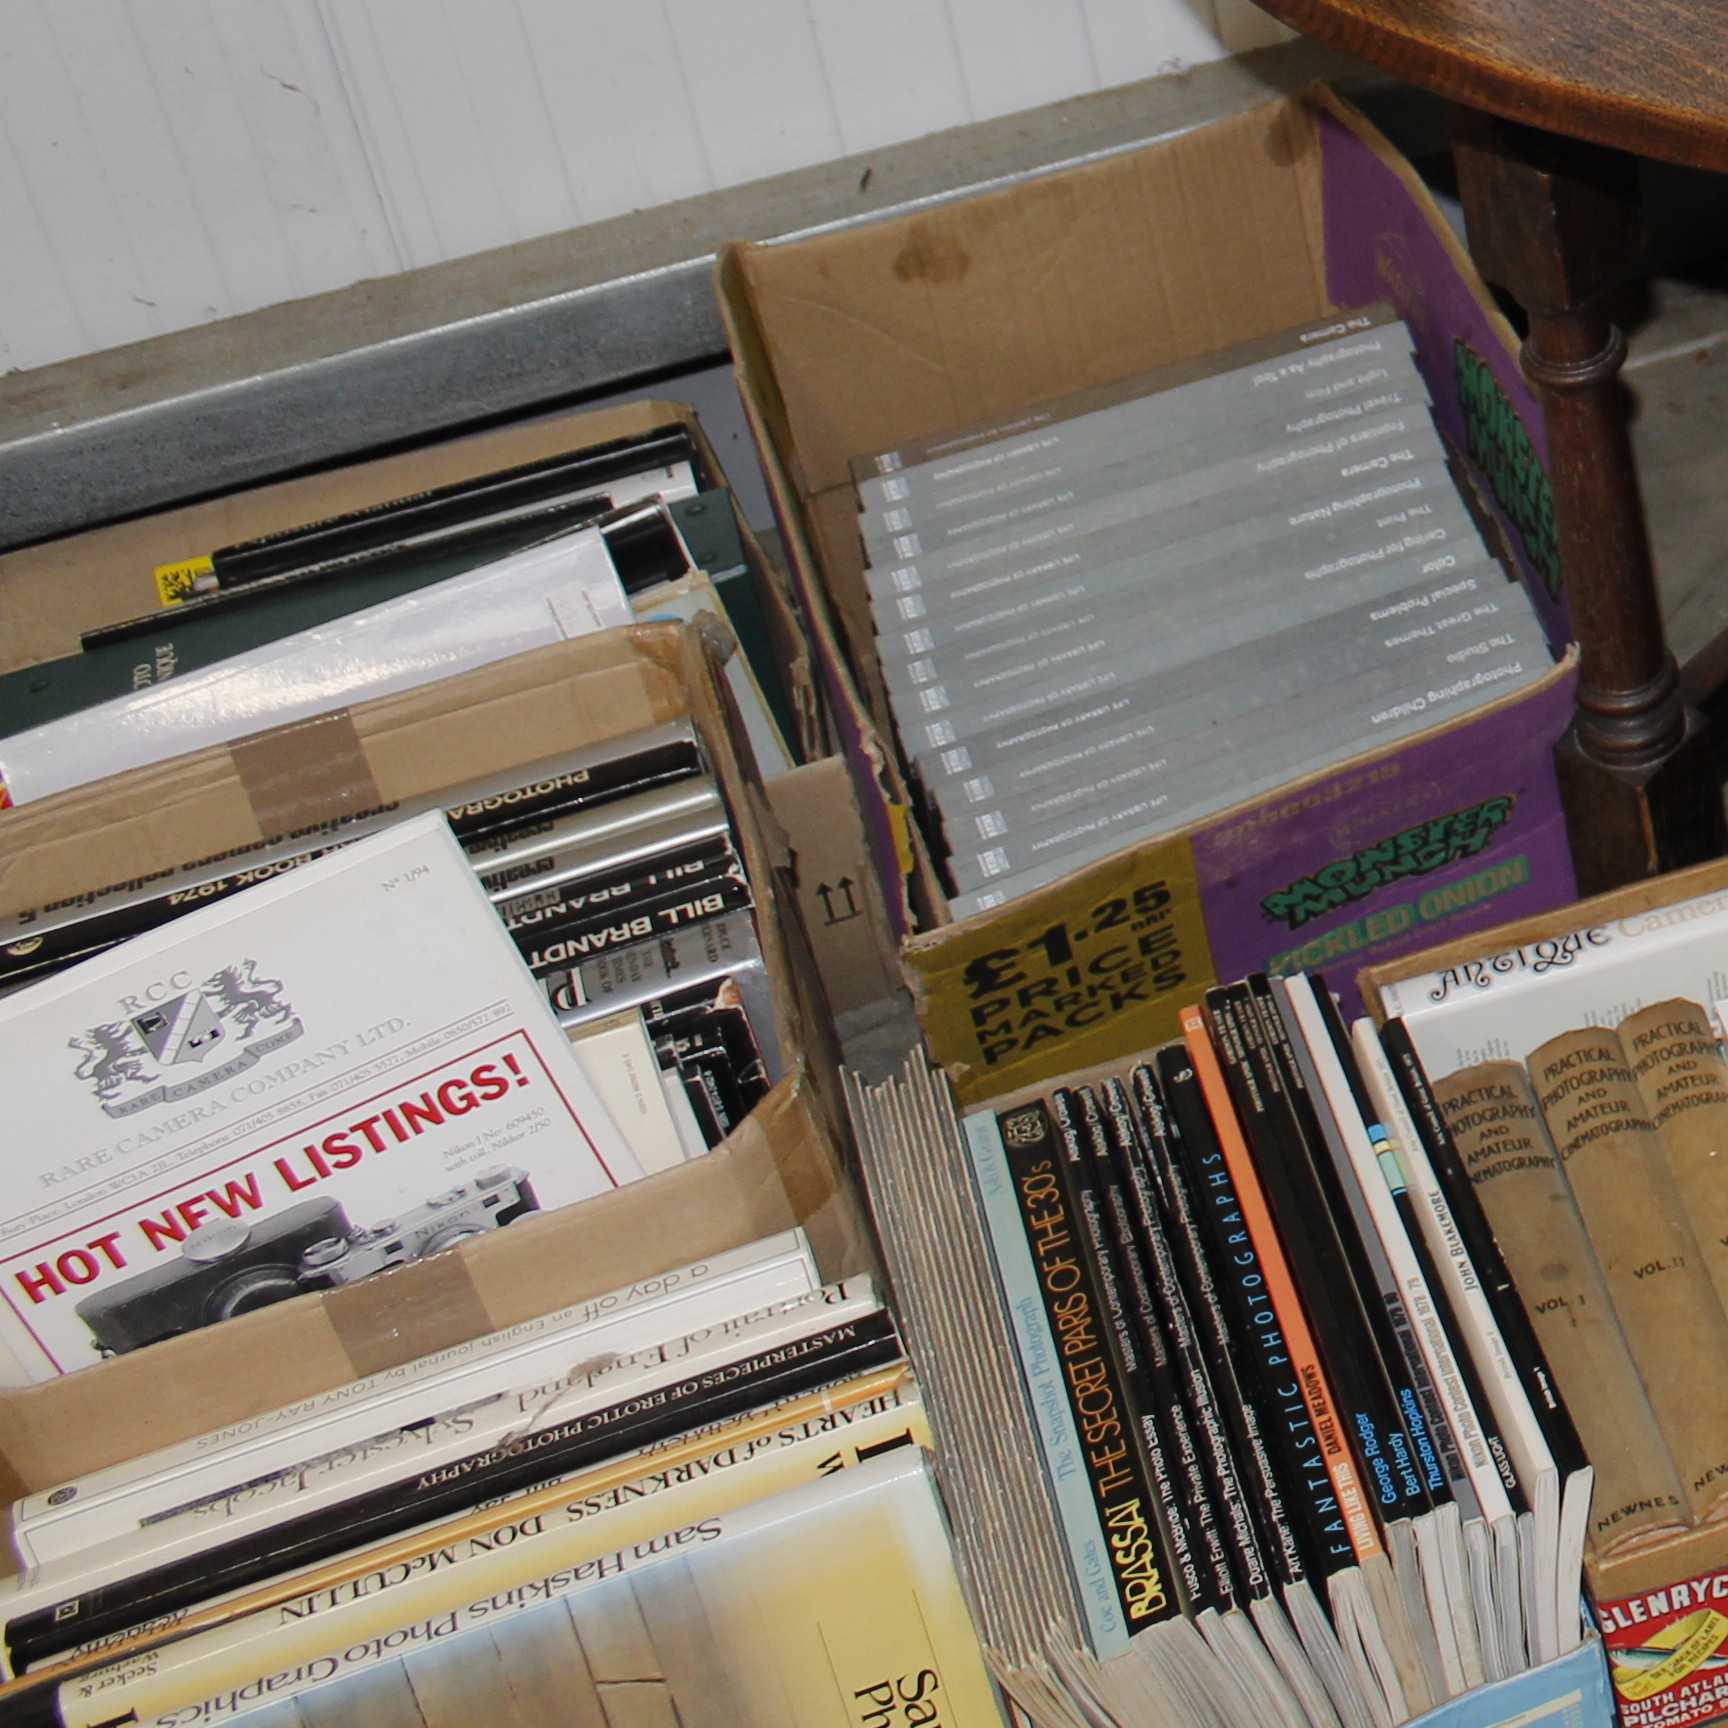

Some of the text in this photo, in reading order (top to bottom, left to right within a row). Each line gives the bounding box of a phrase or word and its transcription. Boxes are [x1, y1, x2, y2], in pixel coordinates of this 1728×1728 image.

[168, 880, 229, 906] 1974
[528, 893, 725, 970] BILL BRANDT
[1267, 859, 1527, 977] PICKLED ONION
[963, 880, 1174, 999] £1.25
[968, 924, 1178, 1030] PRICE
[1430, 924, 1613, 1002] ANTIQUE
[117, 970, 196, 1016] RCC
[976, 947, 1182, 1045] MARKED
[981, 970, 1187, 1067] PACKS
[38, 1015, 413, 1189] RARE CAMERA COMPANY LTD.
[1543, 1046, 1617, 1083] PRACTICAL
[1577, 1087, 1608, 1106] AND
[1566, 1101, 1631, 1133] AMATEUR
[14, 1051, 531, 1305] HOT NEW LISTINGS!
[1029, 1204, 1070, 1257] THE
[1041, 1256, 1081, 1292] OF
[1429, 1189, 1479, 1291] JOHN BLAKEMORE
[1053, 1292, 1098, 1357] PARIS
[1202, 1151, 1352, 1556] FANTASTIC PHOTOGRAPHS
[195, 1379, 379, 1452] TONY RAY-JONES
[417, 1324, 856, 1491] MASTERPIECES OF EROTIC PHOTOGRAPHY
[1068, 1357, 1121, 1443] SECRET
[1301, 1364, 1342, 1455] DANIEL MEADOWS
[1400, 1387, 1443, 1490] Thurston Hopkins
[1091, 1438, 1134, 1498] THE
[1355, 1413, 1397, 1504] George Rodger
[1389, 1432, 1421, 1497] Bert Hardy
[280, 1389, 905, 1626] HEARTS of DARKNESS DON McCULLIN
[1333, 1462, 1375, 1550] LIVING LIKE THIS
[156, 1516, 723, 1728] Sam Haskins Photo Graphics
[1621, 1691, 1674, 1715] SOUTH
